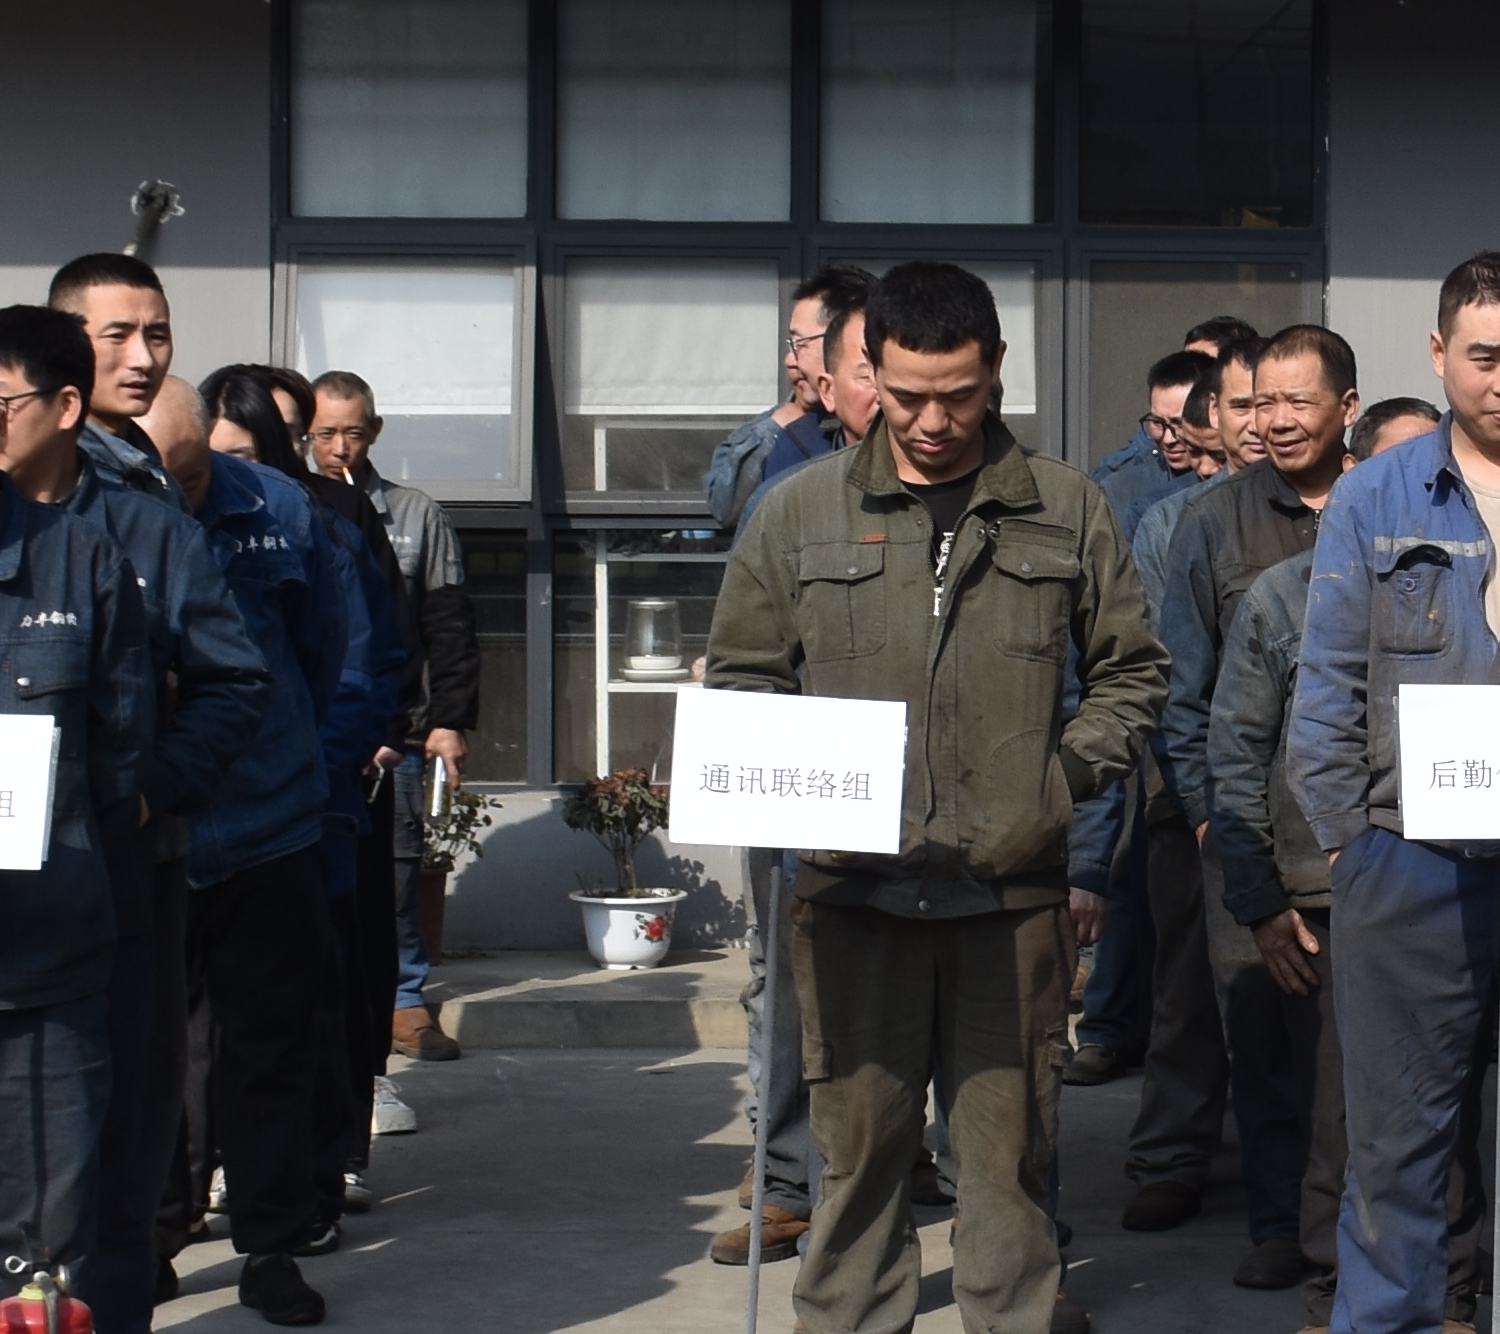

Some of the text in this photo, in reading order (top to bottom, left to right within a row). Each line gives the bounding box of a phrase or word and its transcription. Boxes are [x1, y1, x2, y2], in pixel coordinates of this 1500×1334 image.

[699, 763, 873, 801] 通讯联络组
